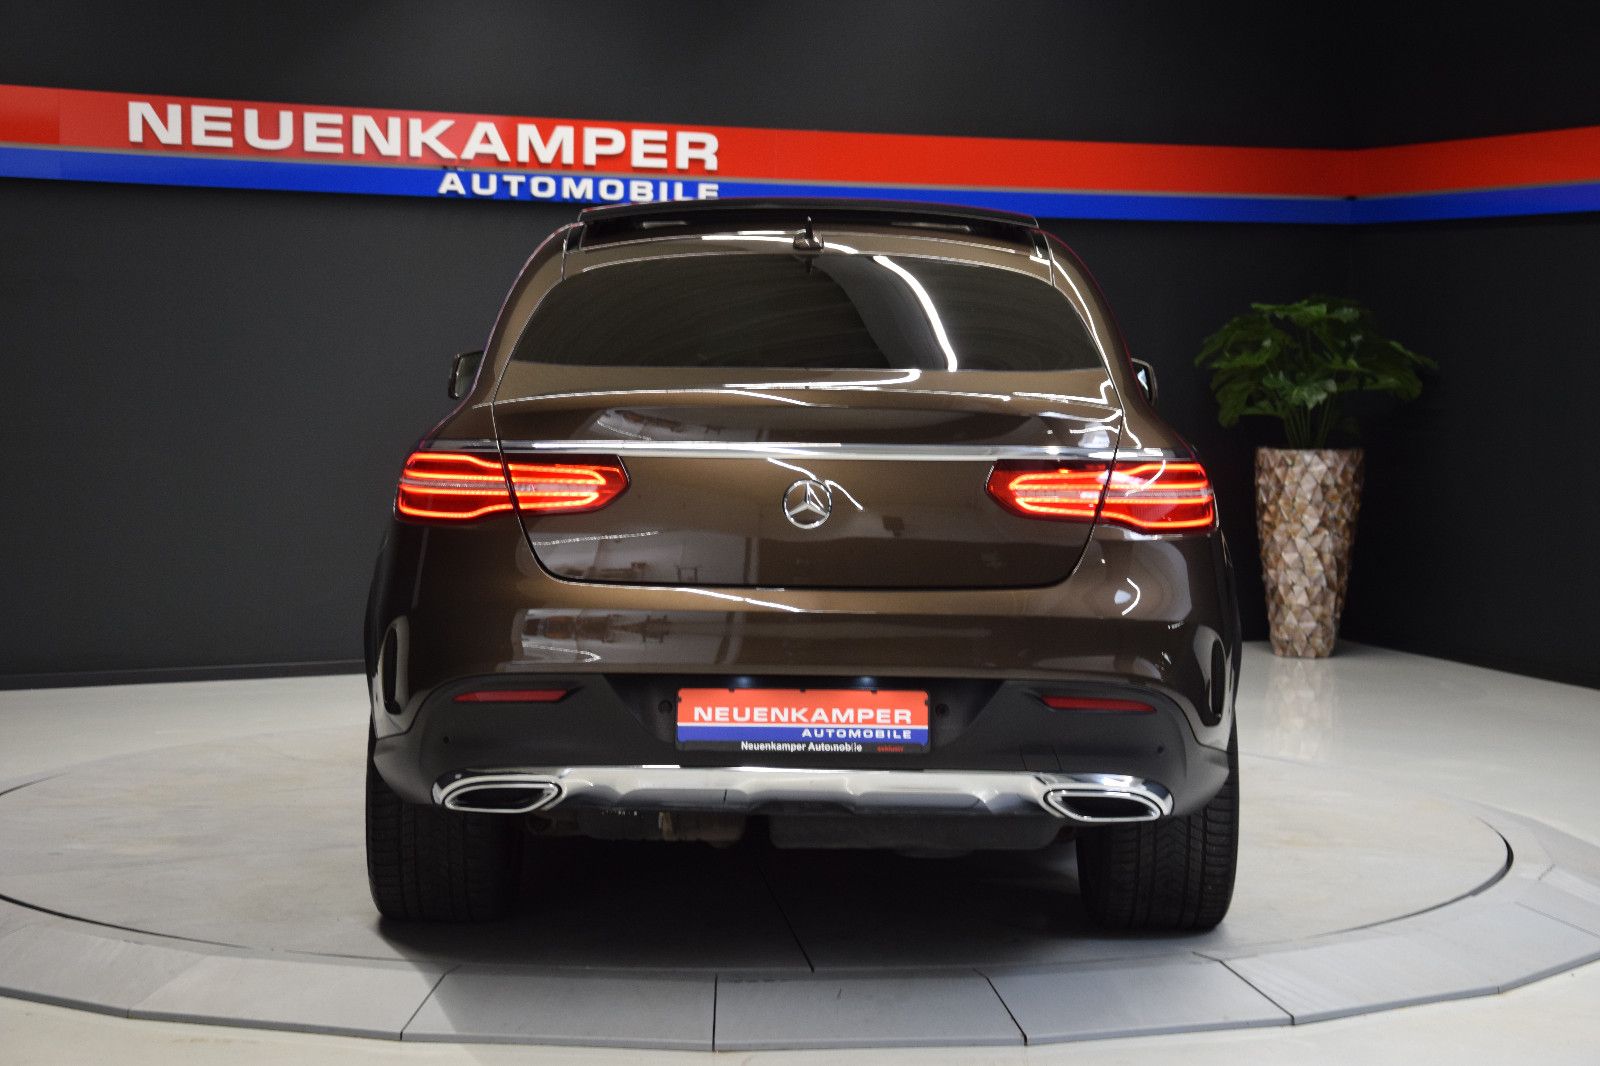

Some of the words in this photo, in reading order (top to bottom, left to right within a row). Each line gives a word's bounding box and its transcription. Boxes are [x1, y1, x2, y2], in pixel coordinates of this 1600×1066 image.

[127, 101, 720, 171] NEUENKAMPER
[437, 172, 720, 202] AUTOMOBILE
[693, 706, 912, 724] NEUENKAMPER
[802, 728, 912, 739] AUTOMOBILE
[741, 741, 806, 752] Neuenkamper
